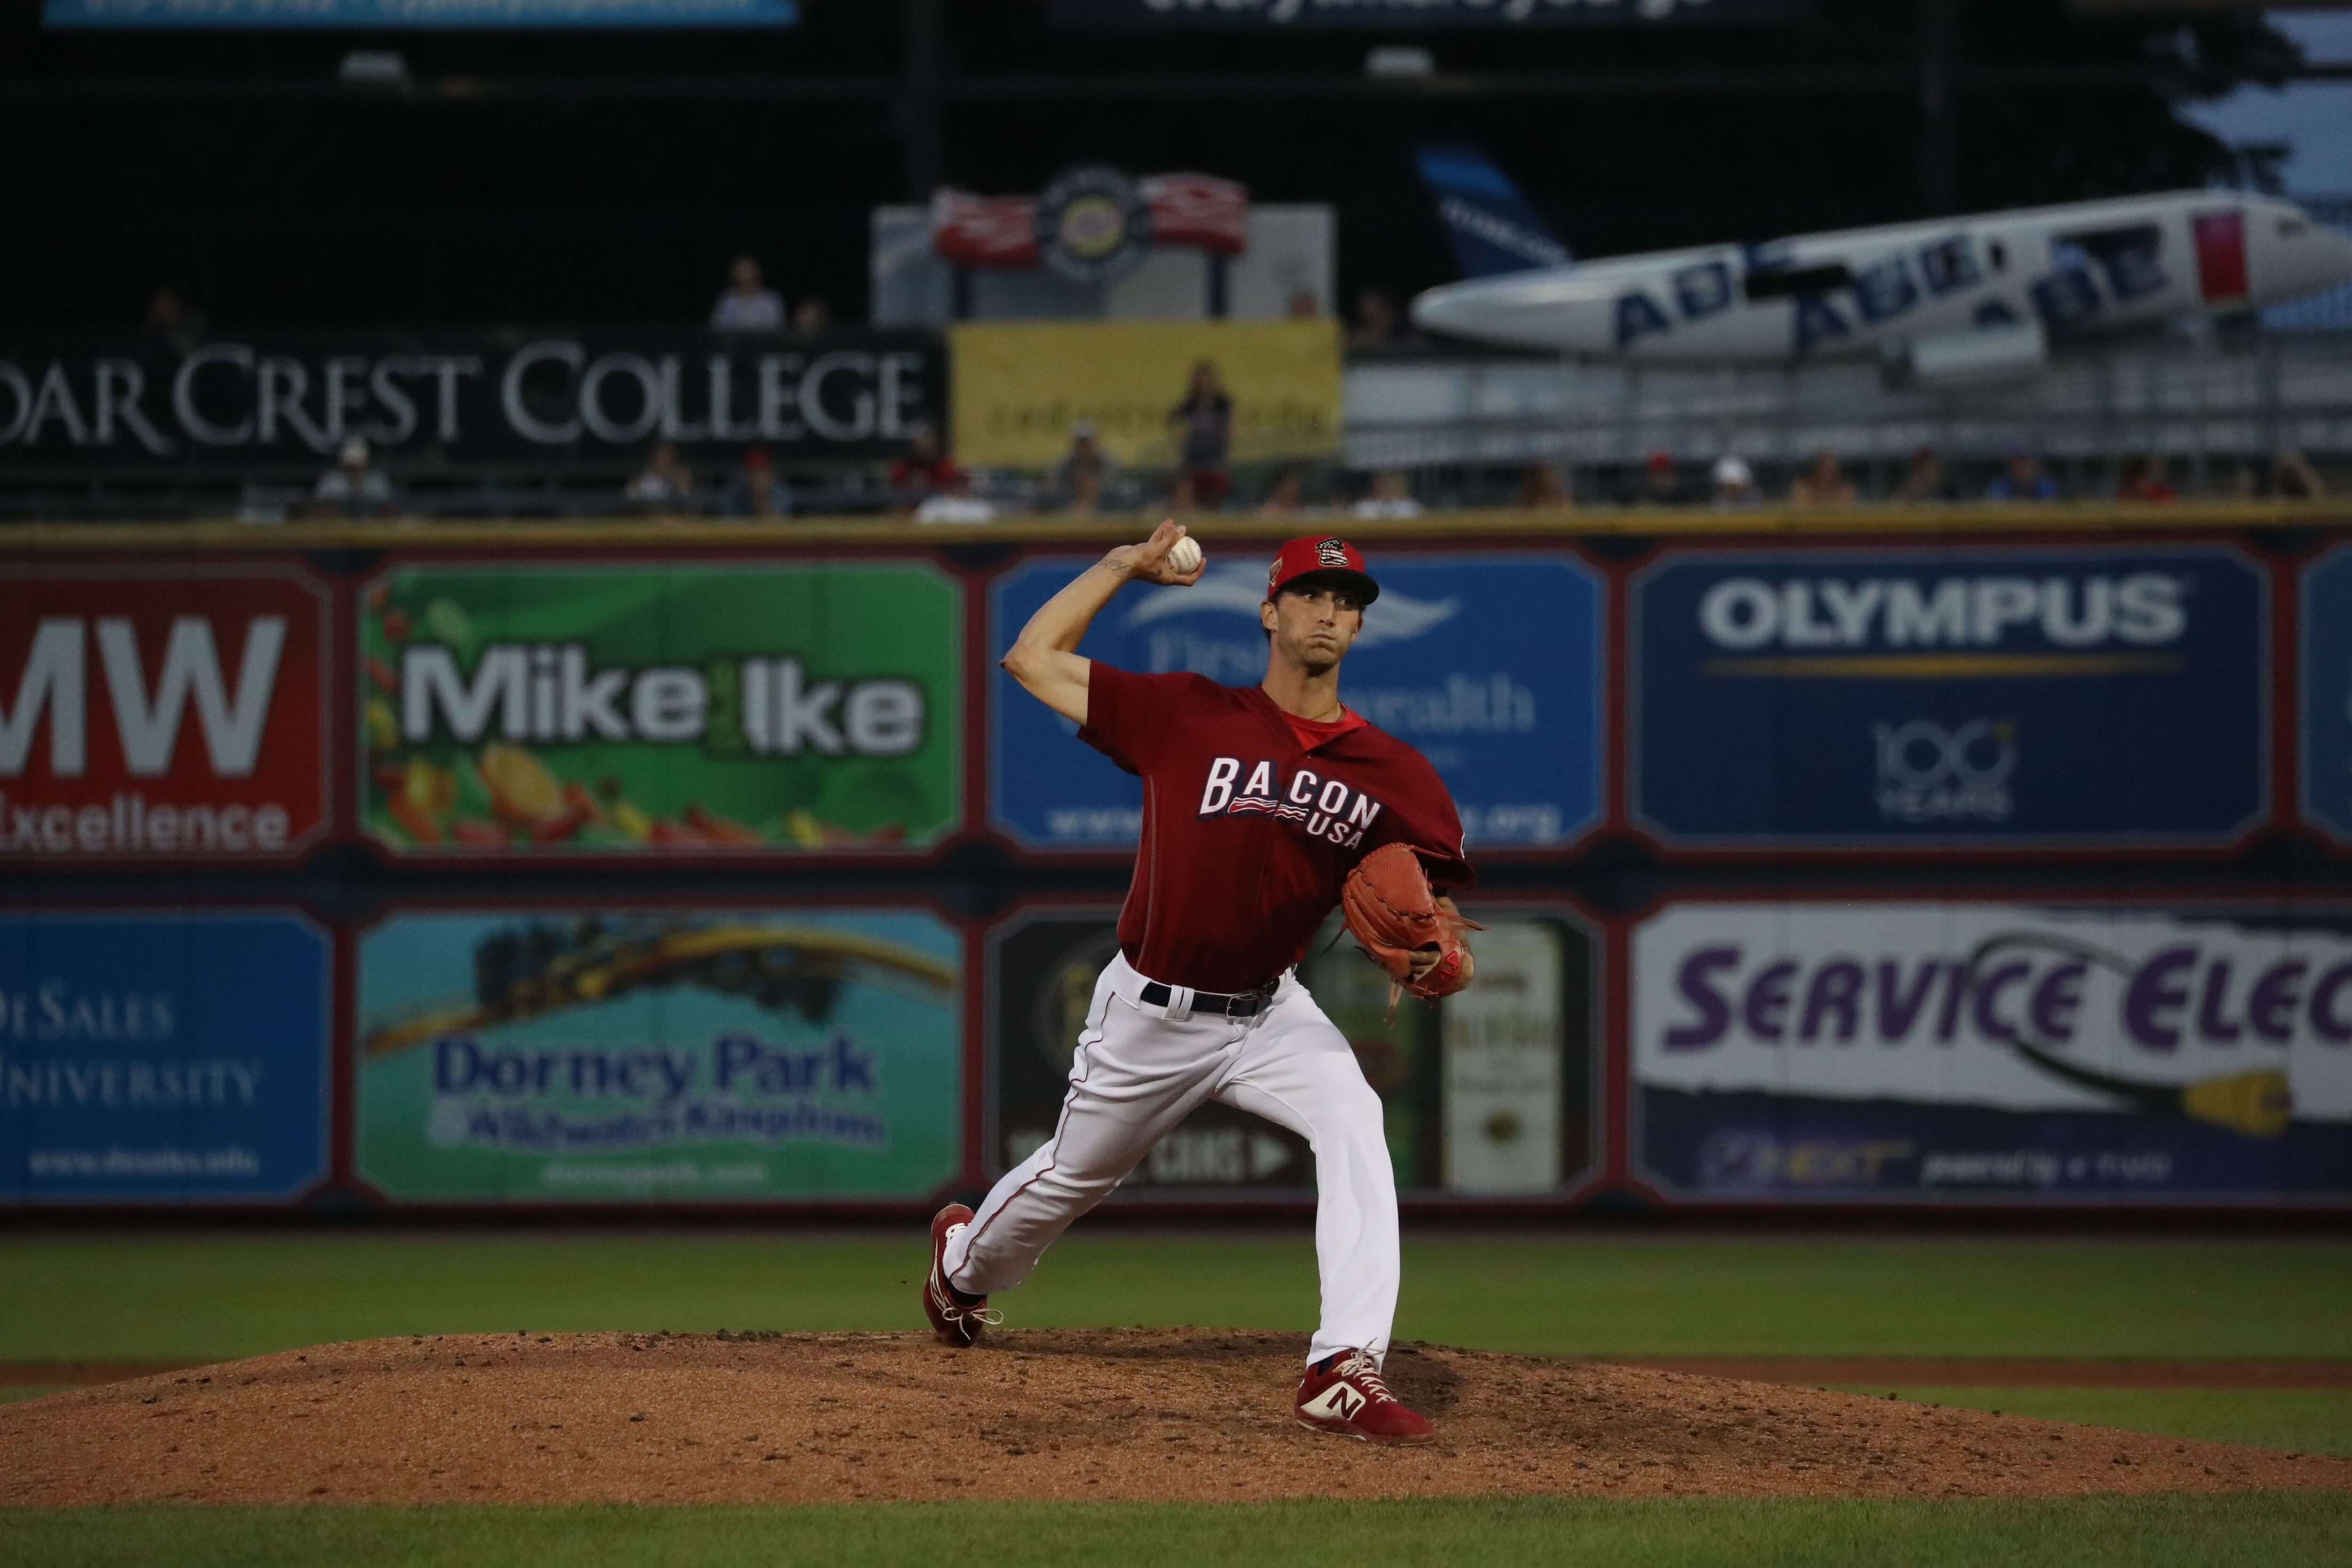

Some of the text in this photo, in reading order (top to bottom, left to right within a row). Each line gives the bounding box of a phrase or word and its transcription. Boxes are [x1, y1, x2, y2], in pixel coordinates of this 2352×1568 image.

[173, 342, 485, 456] CREST
[500, 339, 926, 445] COLLEGE
[1698, 571, 2189, 651] OLYMPUS
[401, 642, 709, 744] Mike
[739, 655, 928, 756] Ike
[0, 791, 290, 852] xcellence
[1199, 757, 1381, 831] BACON
[1306, 811, 1365, 851] USA
[1660, 946, 2352, 1054] SERVICE ELEC
[0, 1059, 264, 1107] NIVERSITY
[434, 1030, 875, 1099] Dorney Park
[1326, 1386, 1362, 1419] N
